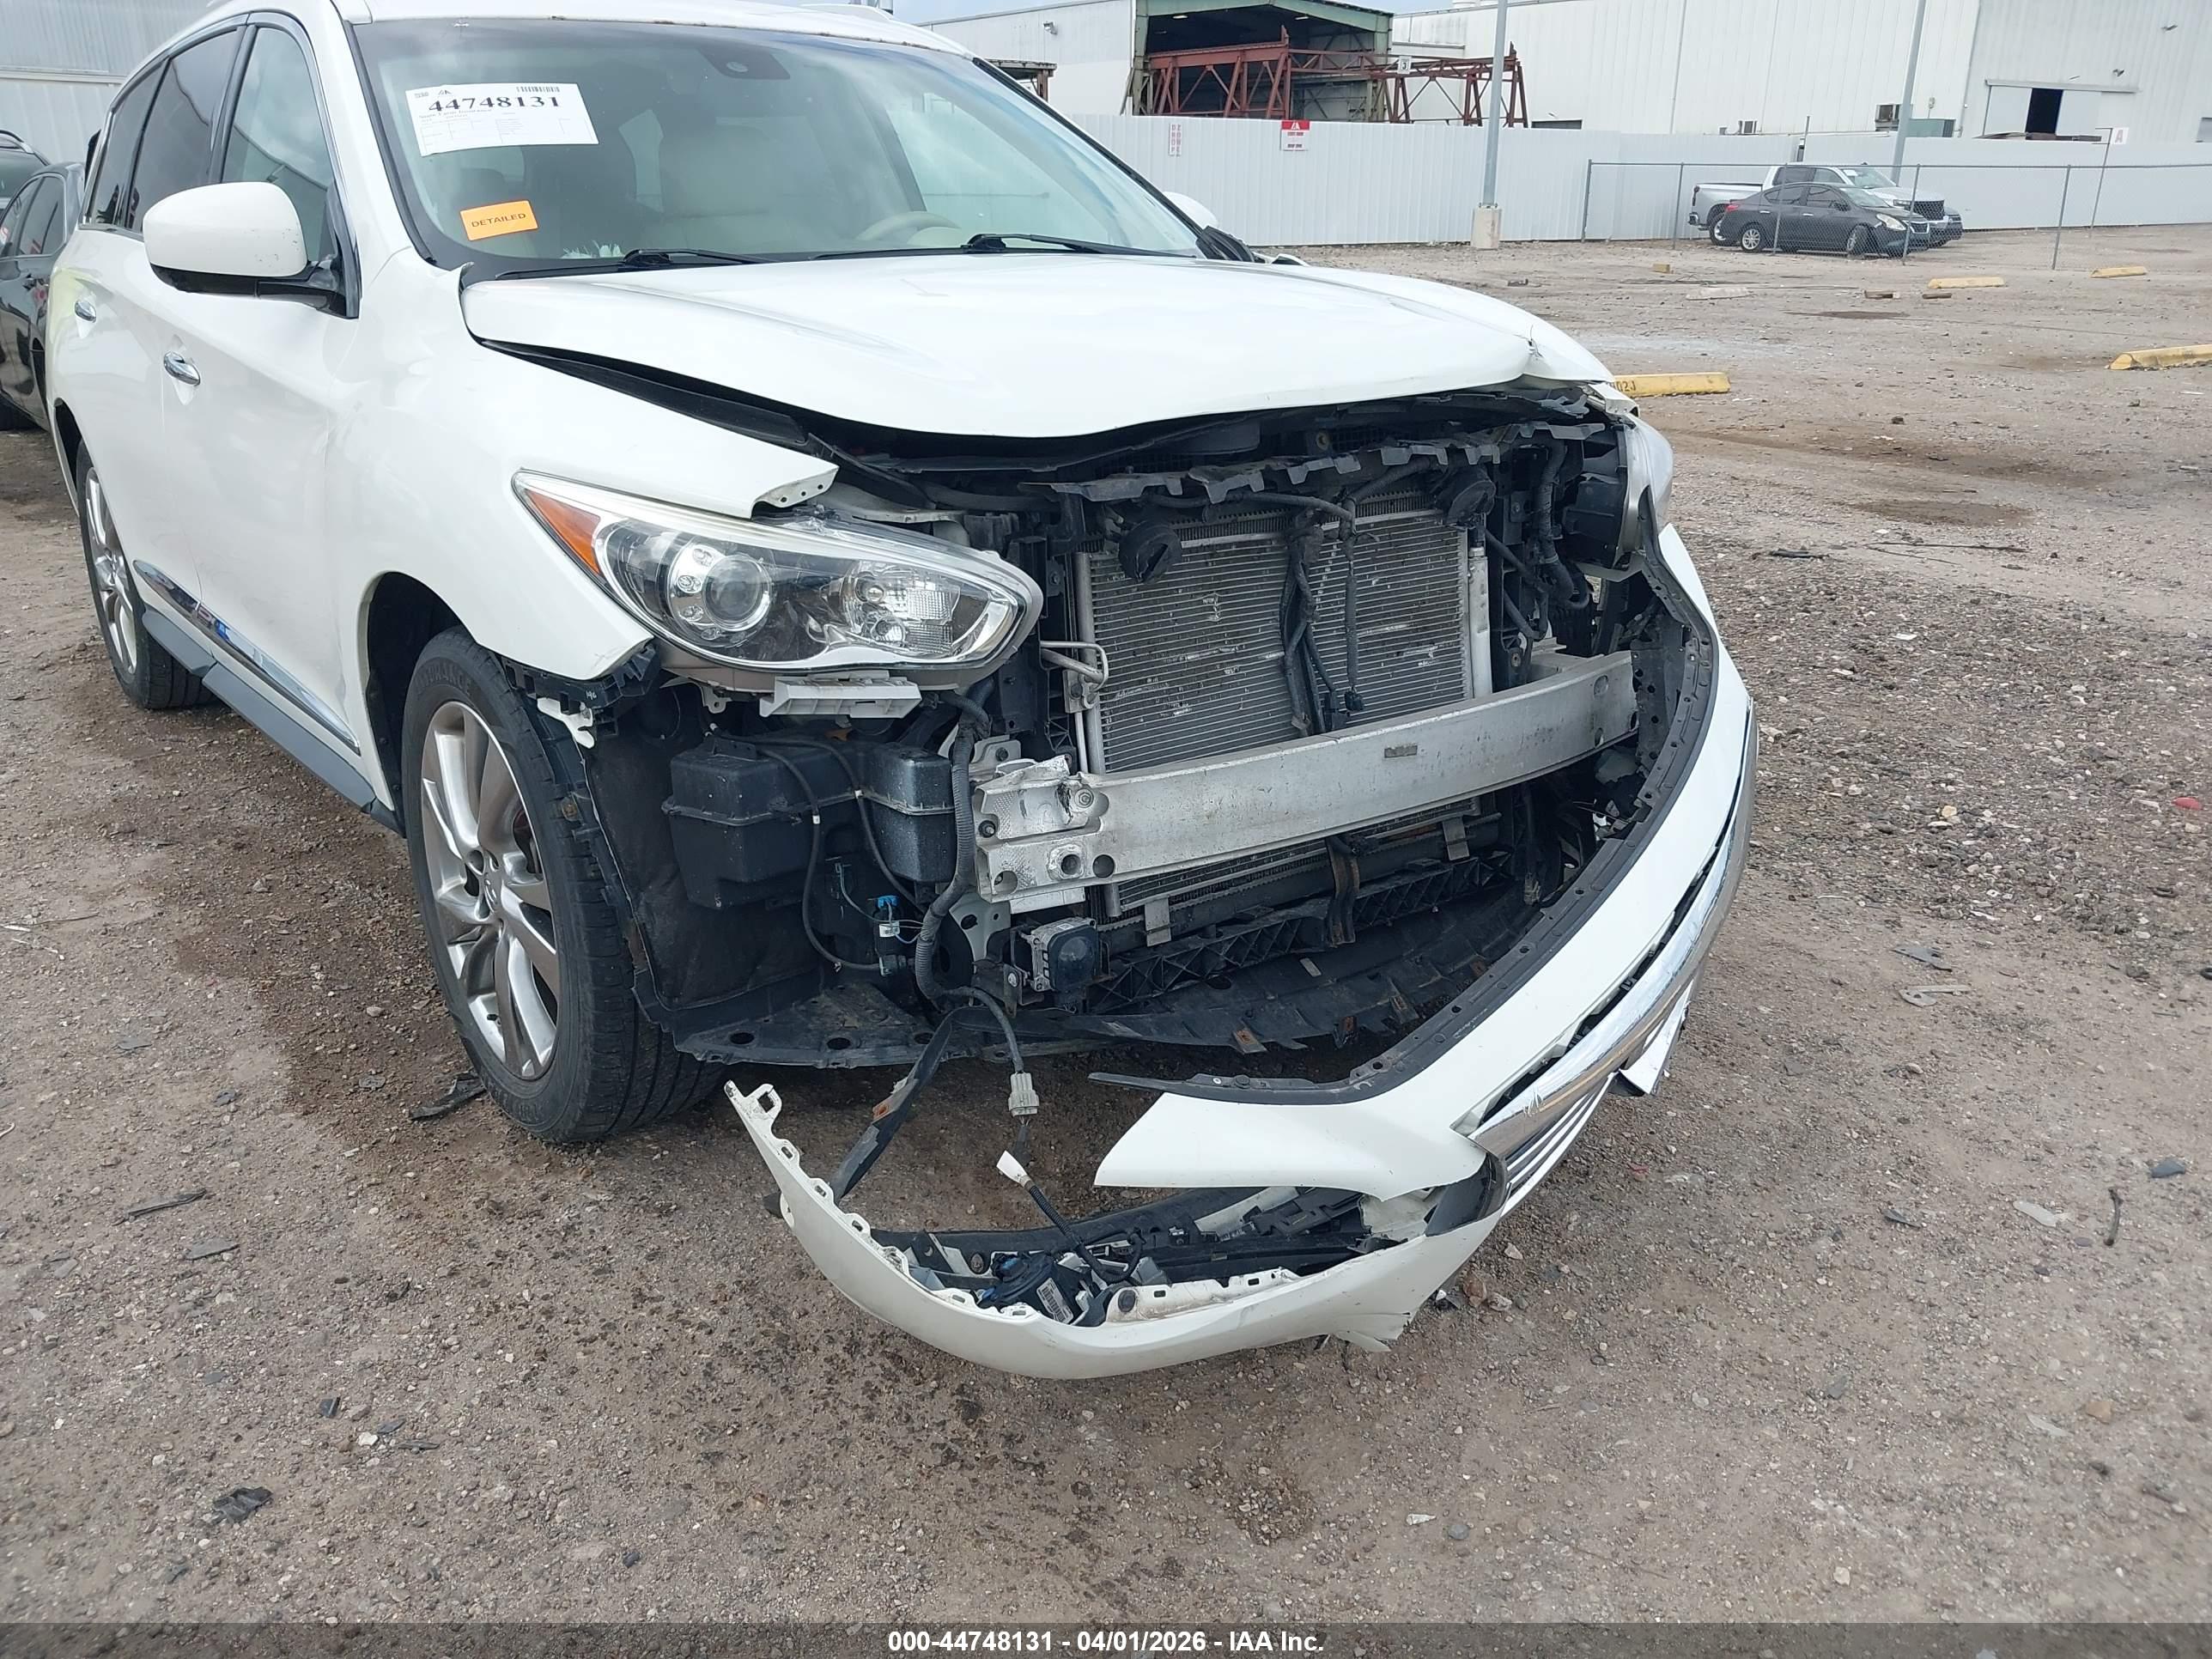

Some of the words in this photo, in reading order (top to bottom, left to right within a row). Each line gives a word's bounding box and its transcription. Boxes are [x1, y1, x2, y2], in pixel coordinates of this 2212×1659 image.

[428, 96, 560, 112] 44748131
[2114, 129, 2124, 143] A
[471, 213, 526, 228] DETAILED
